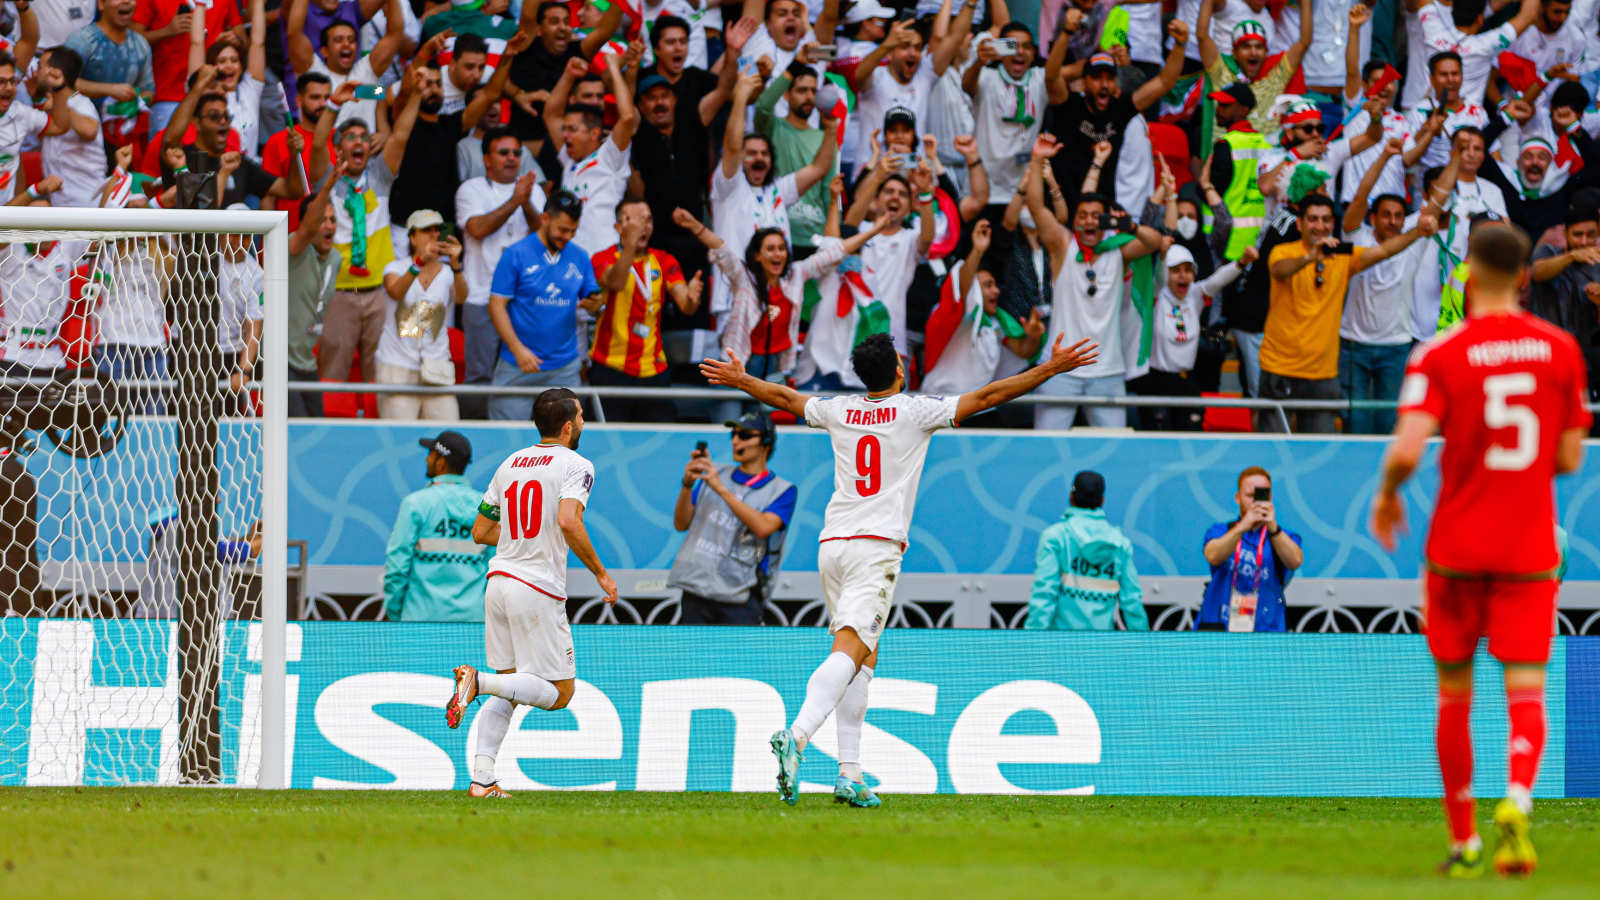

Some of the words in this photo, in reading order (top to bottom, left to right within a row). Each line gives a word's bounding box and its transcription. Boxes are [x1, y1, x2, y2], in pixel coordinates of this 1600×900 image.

[845, 406, 897, 426] TAREMI
[1483, 371, 1540, 471] 5
[511, 455, 554, 468] KARIM
[856, 434, 881, 498] 9
[505, 480, 543, 540] 10
[26, 620, 1102, 795] Hisense
